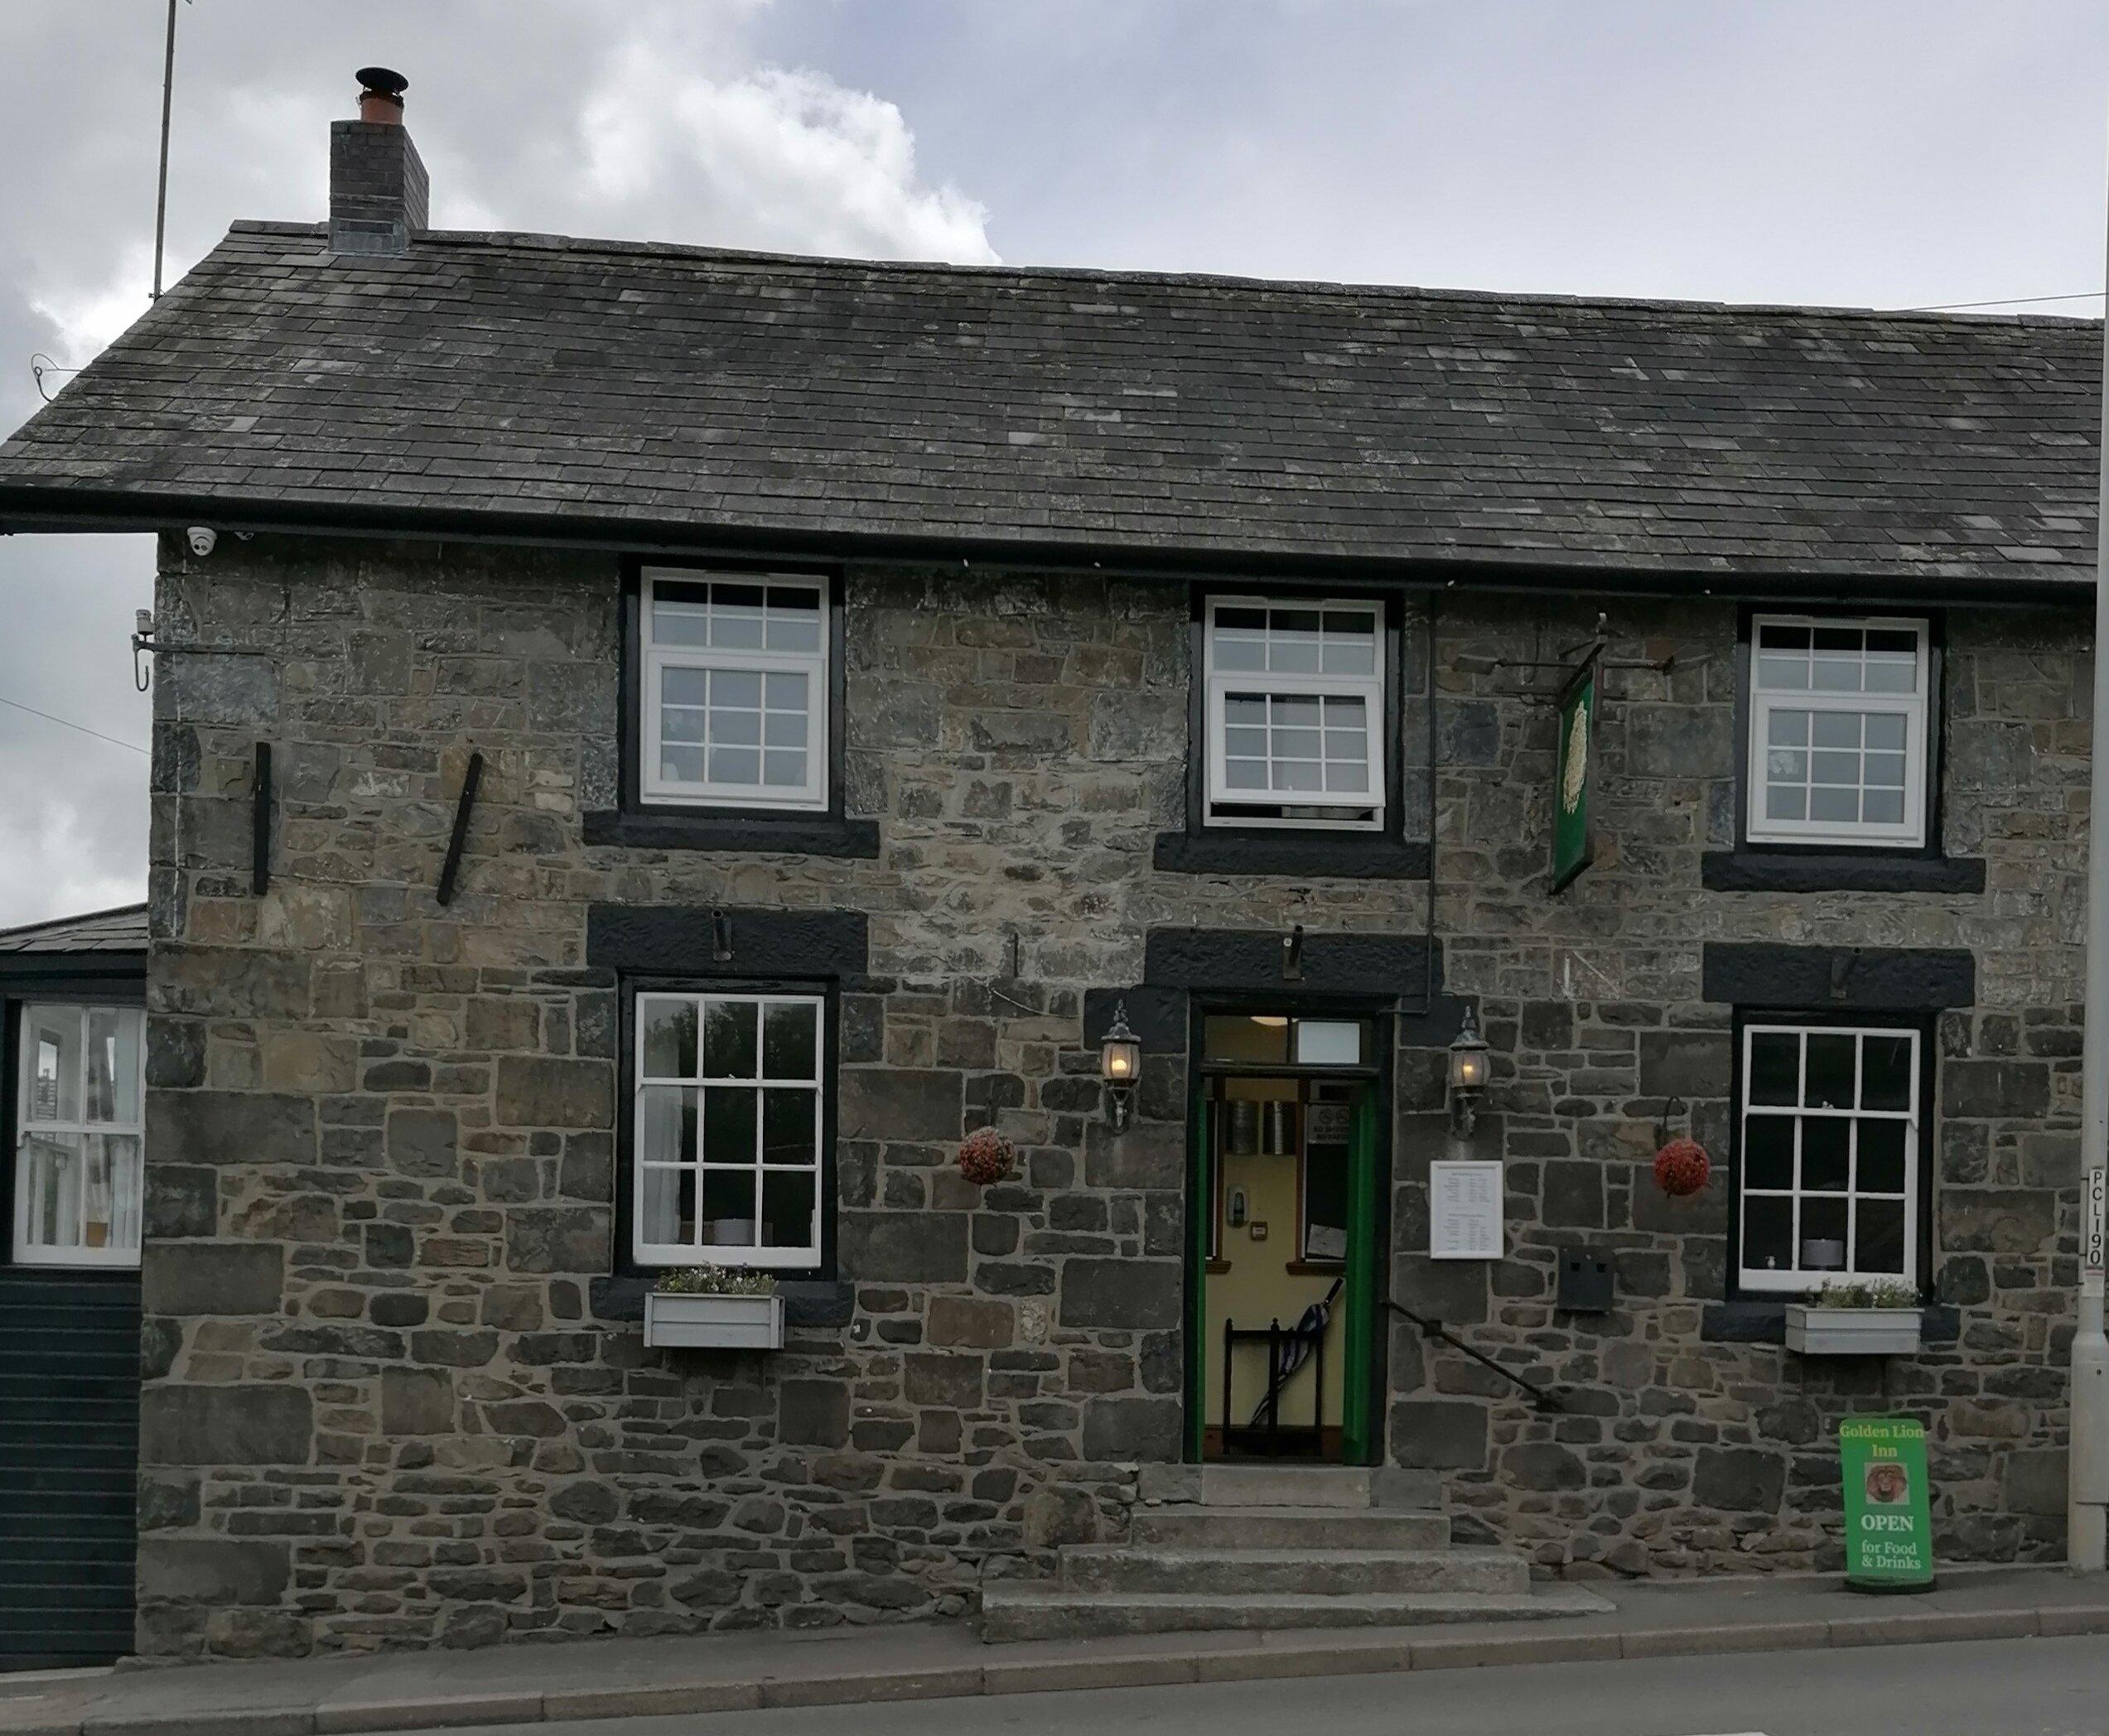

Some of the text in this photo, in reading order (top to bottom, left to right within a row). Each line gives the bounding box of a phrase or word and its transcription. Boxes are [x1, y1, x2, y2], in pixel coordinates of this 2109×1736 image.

[1839, 1425, 1924, 1439] Golden Lion
[1871, 1444, 1898, 1458] Inn
[1860, 1514, 1914, 1531] OPEN
[1861, 1539, 1917, 1555] for Food
[1861, 1555, 1922, 1570] & Drinks
